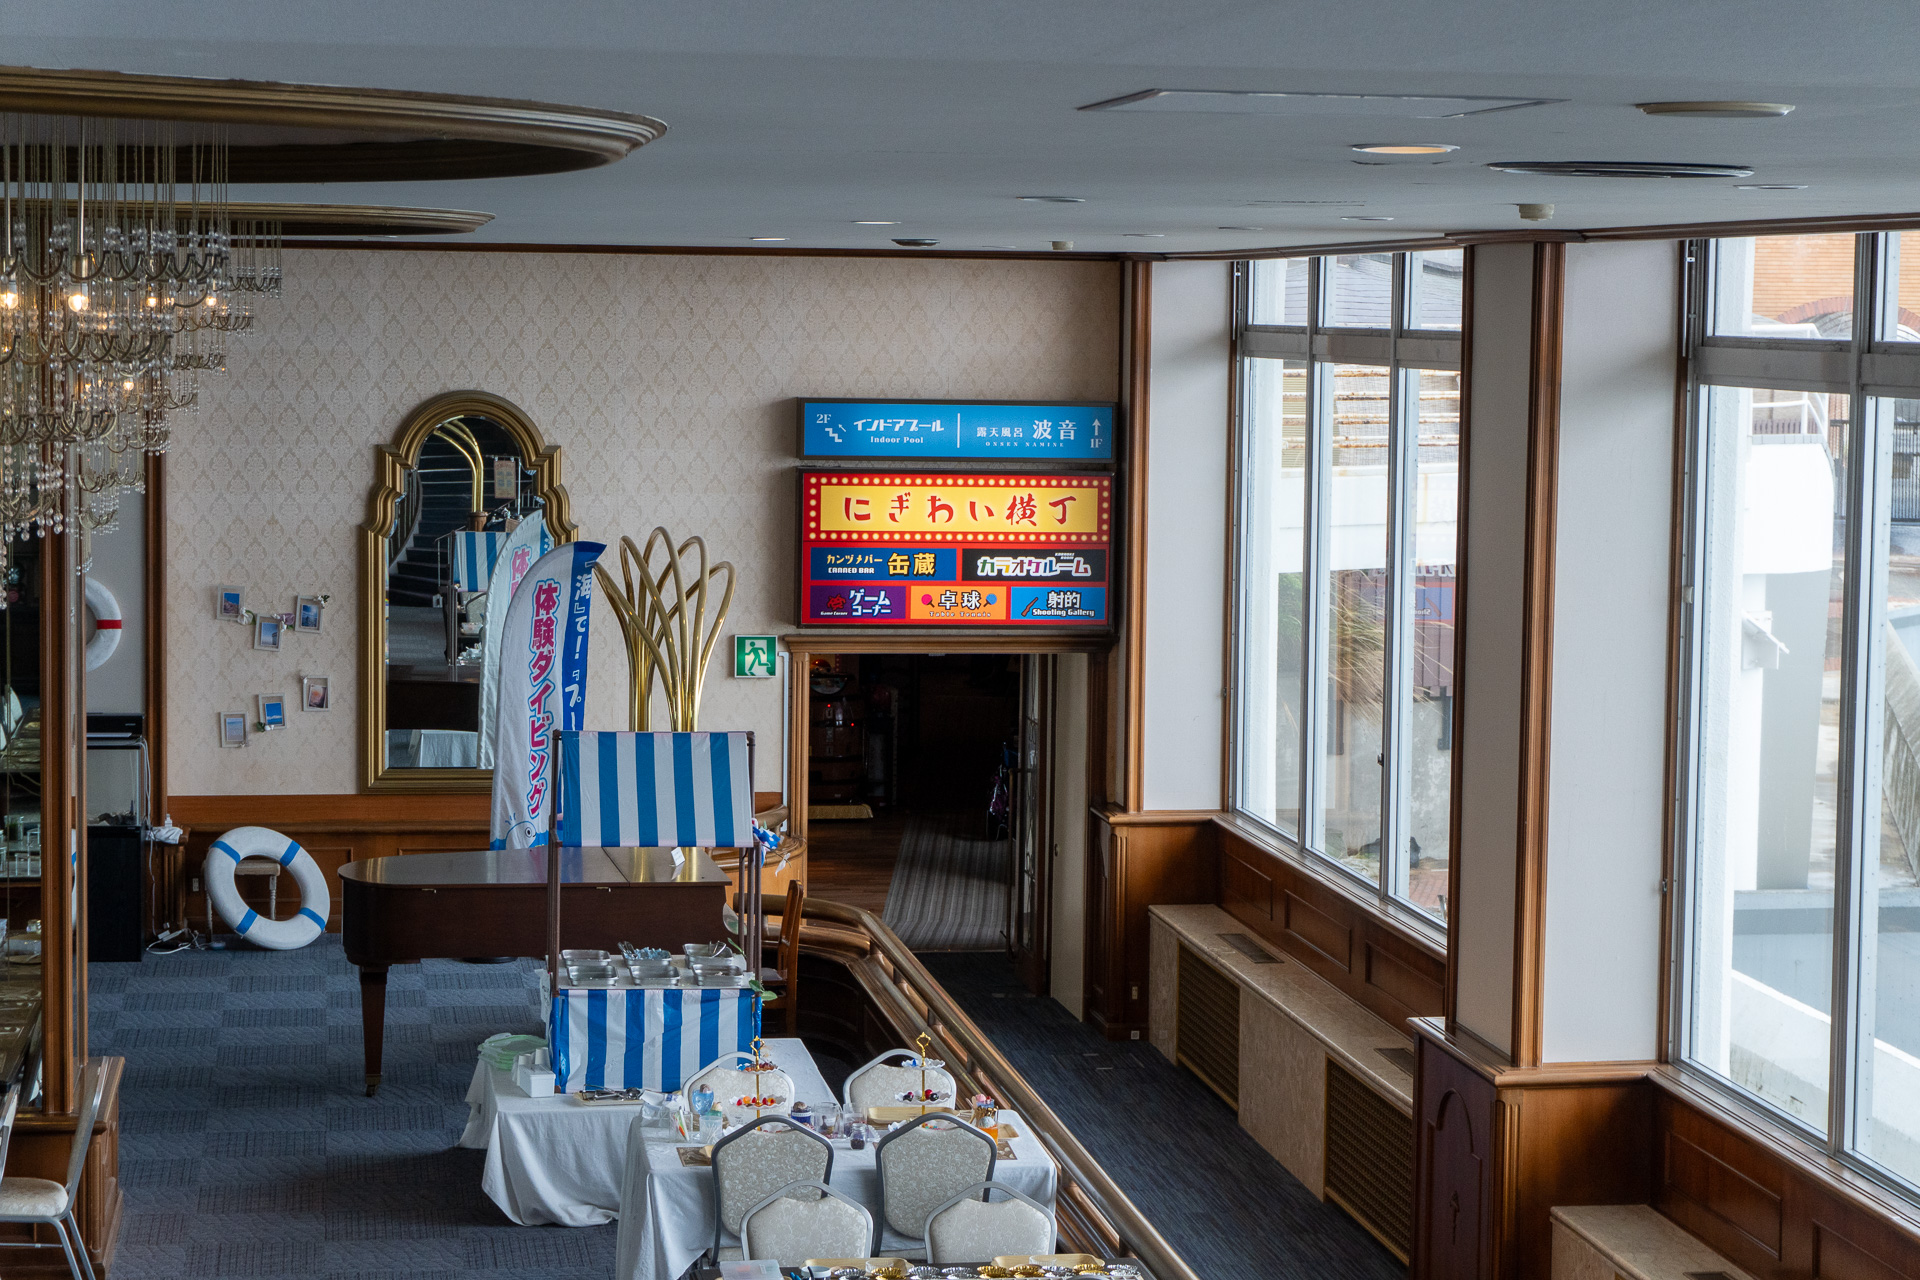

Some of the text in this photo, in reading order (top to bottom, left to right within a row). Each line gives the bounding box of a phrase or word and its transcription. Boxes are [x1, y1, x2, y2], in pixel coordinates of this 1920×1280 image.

[816, 413, 831, 424] 2F
[853, 418, 945, 432] インドアプール
[976, 419, 1078, 441] 露天風呂 波音
[870, 436, 924, 444] Indoor Pool
[1090, 438, 1103, 449] 1F
[844, 491, 1077, 527] にぎわい横丁
[887, 552, 936, 576] 缶蔵
[977, 556, 1092, 577] カラオケルーム
[849, 587, 891, 606] ゲーム
[938, 590, 982, 610] 卓球
[1047, 590, 1082, 609] 射的
[851, 605, 892, 617] コーナー
[1032, 608, 1096, 618] Shooting Gallery
[529, 580, 560, 817] 体験ダイビング
